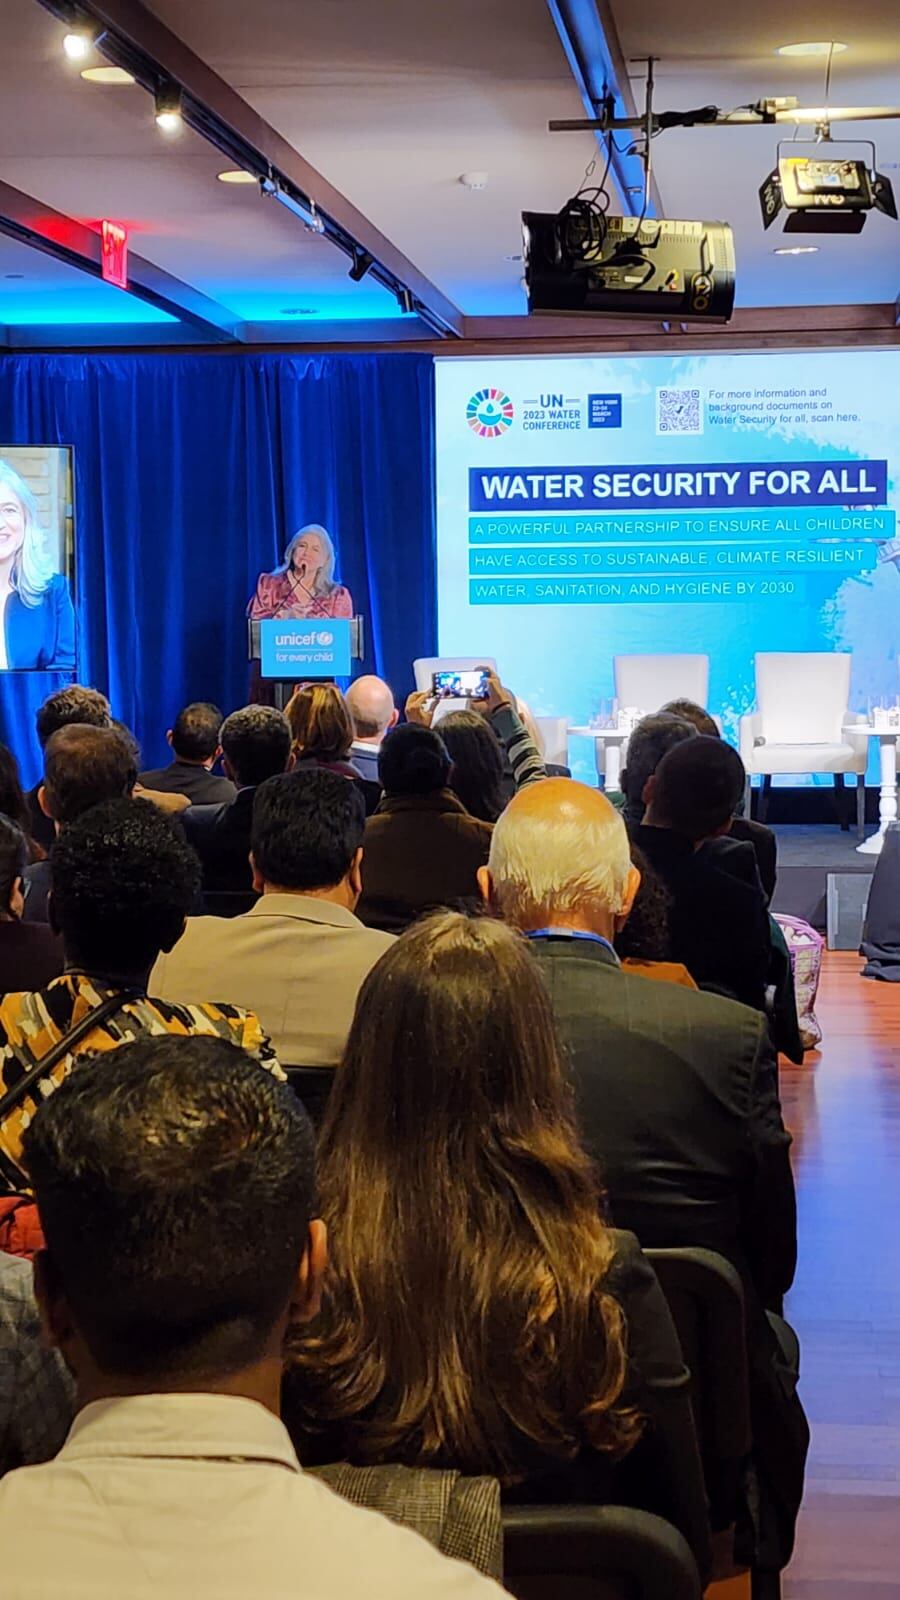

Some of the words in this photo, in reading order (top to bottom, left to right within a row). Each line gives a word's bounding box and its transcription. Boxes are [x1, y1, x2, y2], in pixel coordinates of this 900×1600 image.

[709, 390, 725, 399] For
[754, 388, 806, 398] information
[809, 388, 827, 397] and
[540, 394, 563, 408] UN
[708, 402, 763, 413] background
[766, 401, 818, 411] documents
[820, 401, 833, 409] on
[523, 410, 545, 420] 2023
[549, 409, 580, 419] WATER
[708, 415, 737, 424] Water
[739, 414, 777, 425] Security
[780, 414, 792, 423] for
[811, 414, 834, 422] scan
[523, 420, 580, 430] CONFERENCE
[481, 474, 584, 499] WATER
[592, 472, 741, 498] SECURITY
[749, 470, 811, 495] FOR
[817, 469, 877, 494] ALL
[475, 524, 484, 535] A
[488, 522, 570, 535] POWERFUL
[575, 520, 680, 534] PARTNERSHIP
[685, 520, 704, 533] TO
[709, 519, 771, 533] ENSURE
[775, 518, 801, 531] ALL
[806, 517, 885, 531] CHILDREN
[475, 554, 513, 567] HAVE
[517, 553, 578, 566] ACCESS
[583, 553, 602, 566] TO
[717, 550, 780, 564] CLIMATE
[786, 549, 864, 563] RESILIENT
[629, 583, 660, 596] AND
[665, 582, 731, 595] HYGIENE
[736, 582, 756, 594] BY
[760, 581, 795, 594] 2030
[275, 632, 316, 646] unicef
[276, 653, 288, 662] for
[289, 654, 313, 664] every
[314, 652, 333, 662] child
